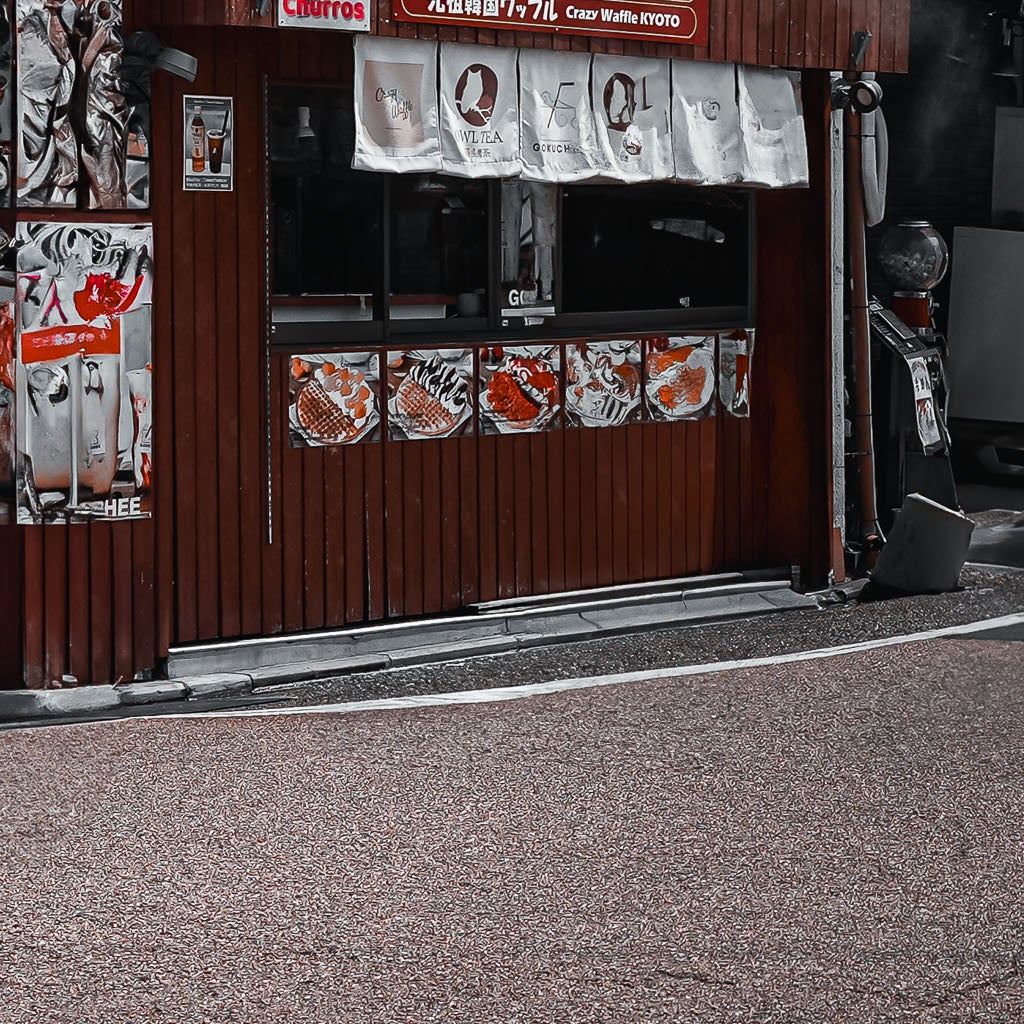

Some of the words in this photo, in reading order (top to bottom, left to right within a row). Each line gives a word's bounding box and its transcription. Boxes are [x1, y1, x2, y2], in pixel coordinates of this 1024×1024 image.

[565, 4, 598, 23] Crazy
[601, 8, 638, 25] Waffle
[639, 11, 680, 28] KYOTO
[480, 129, 504, 144] TEA
